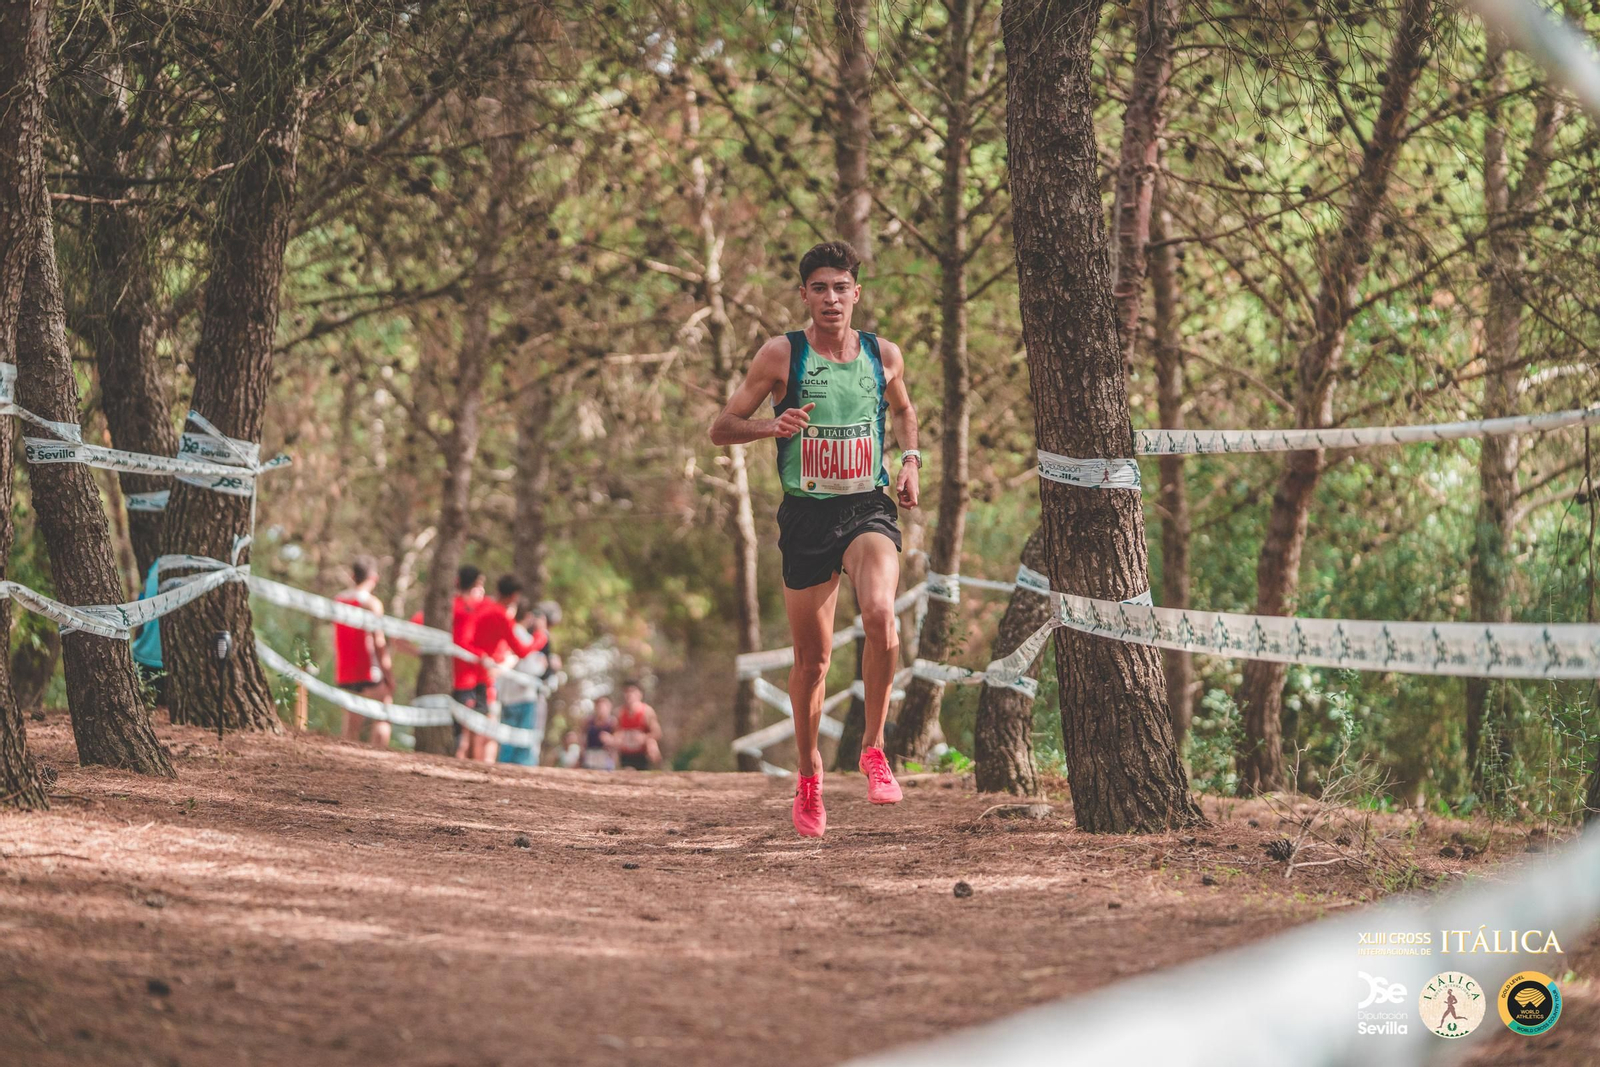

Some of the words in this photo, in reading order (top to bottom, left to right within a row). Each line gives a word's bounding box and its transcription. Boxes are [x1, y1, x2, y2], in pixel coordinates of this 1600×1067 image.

[823, 428, 857, 437] ITÁLICA
[37, 449, 76, 460] Sevilla
[802, 437, 872, 480] MIGALLON
